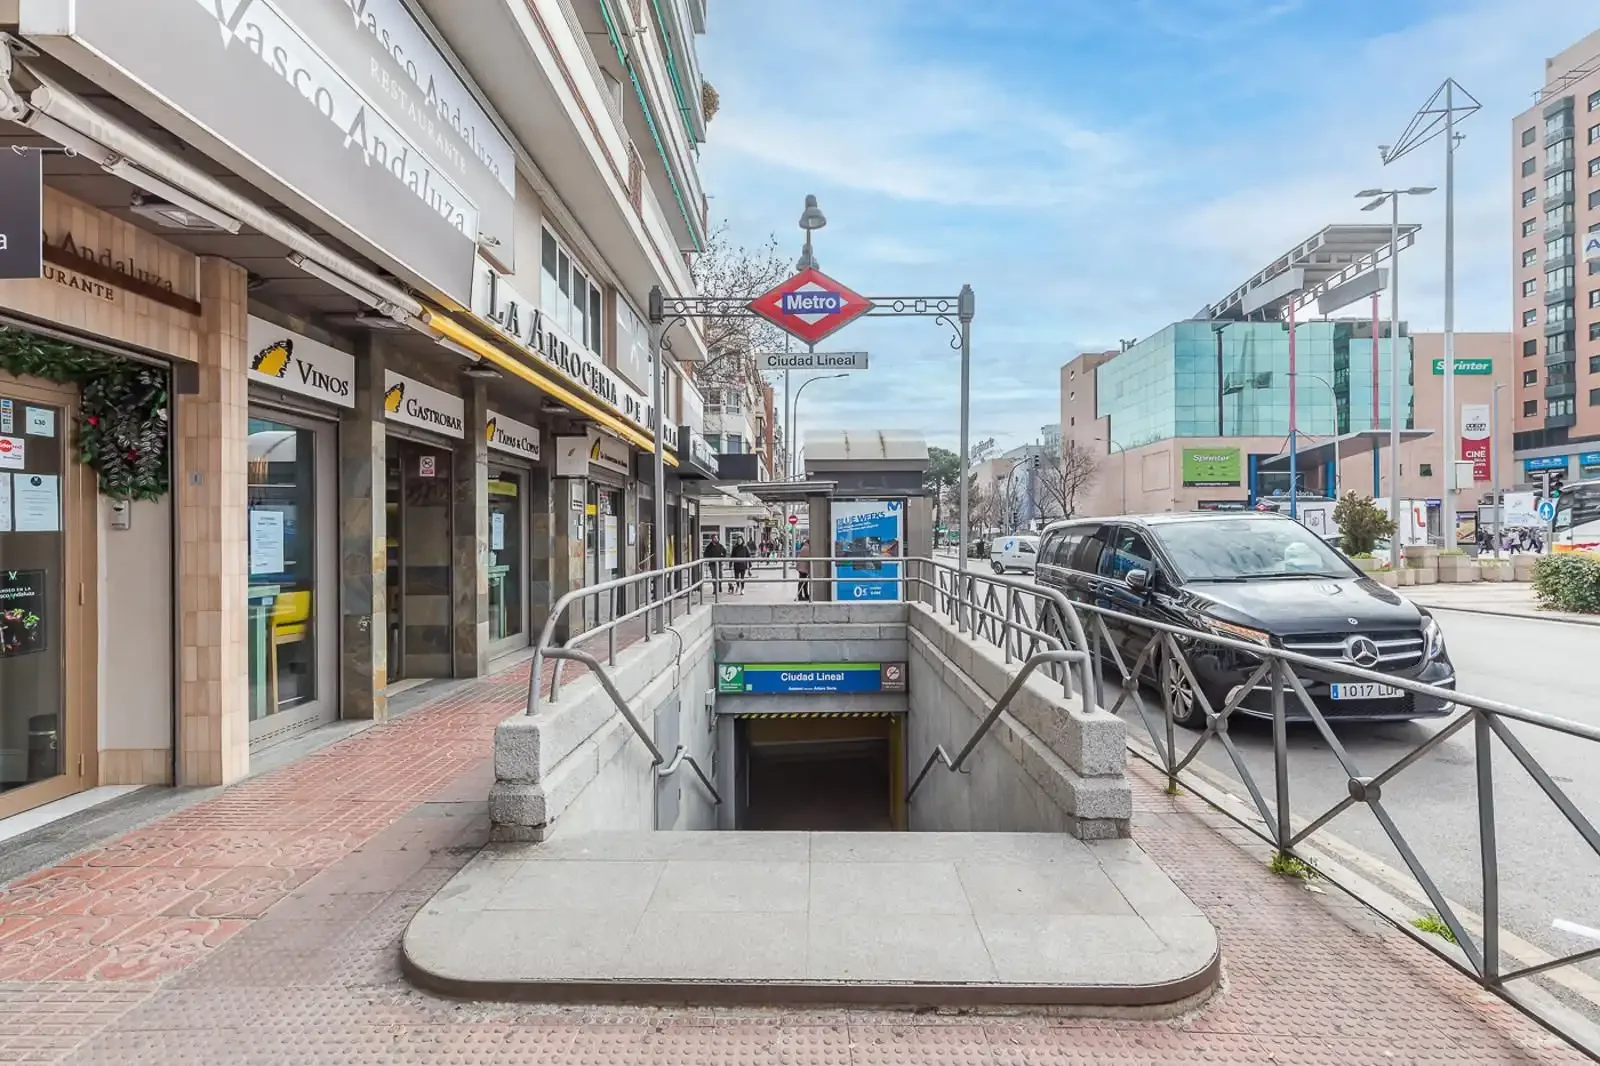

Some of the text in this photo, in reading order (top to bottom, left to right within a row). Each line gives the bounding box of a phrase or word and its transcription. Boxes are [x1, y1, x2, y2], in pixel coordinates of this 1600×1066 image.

[209, 0, 465, 233] Vasco Andaluza
[369, 56, 467, 176] RESTAURANTE
[424, 74, 500, 180] Andaluza
[62, 232, 174, 293] Andaluza
[43, 265, 115, 301] URANTE
[786, 295, 837, 310] Metro
[486, 269, 522, 339] LA
[527, 309, 618, 407] ARROCERIA
[625, 394, 641, 423] DE
[767, 354, 856, 366] Ciudad Lineal
[296, 358, 349, 396] VINOS
[1436, 360, 1489, 371] Srinter
[406, 398, 463, 431] GASTROBAR
[1193, 454, 1231, 463] Sprinter
[1465, 450, 1486, 458] CINE
[780, 672, 844, 682] Ciudad Lineal
[1343, 684, 1374, 697] 1017
